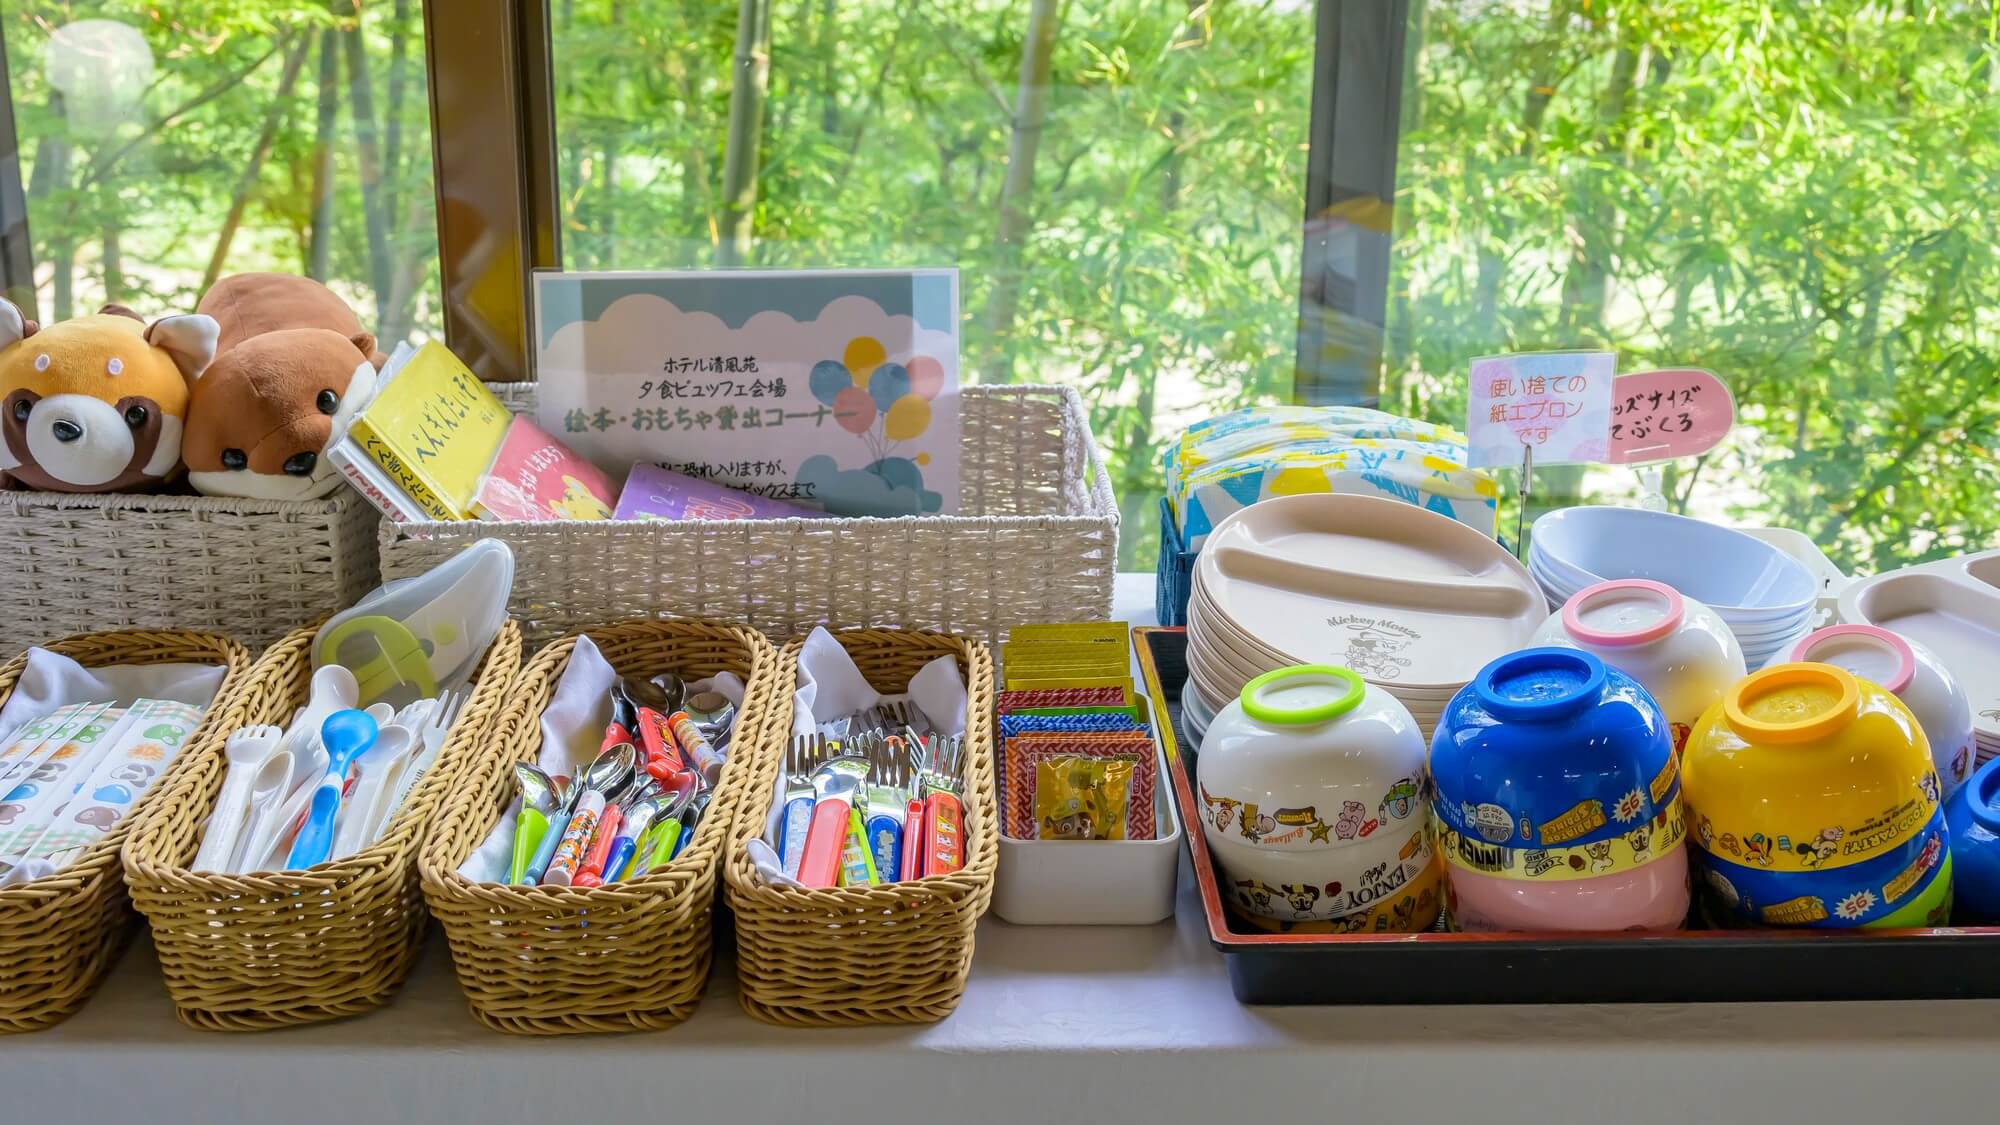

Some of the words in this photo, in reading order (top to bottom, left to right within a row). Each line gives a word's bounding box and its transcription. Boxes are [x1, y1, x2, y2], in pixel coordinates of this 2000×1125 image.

[664, 356, 760, 374] ホテル清風苑
[638, 378, 788, 400] 夕食ビュッフェ会場
[1490, 375, 1587, 399] 使い捨ての
[1489, 400, 1584, 425] 紙エプロン
[1612, 384, 1702, 417] ッズサイズ
[564, 404, 858, 433] 絵本・おもちゃ貸出コーナー
[1515, 426, 1554, 445] です
[1326, 614, 1376, 631] Mickey
[1377, 619, 1422, 639] Mouse
[1620, 793, 1641, 818] 95
[1899, 801, 1926, 832] FOOD
[1843, 825, 1899, 856] PARTY!
[1346, 864, 1408, 911] ENJOY
[1845, 895, 1867, 916] 95
